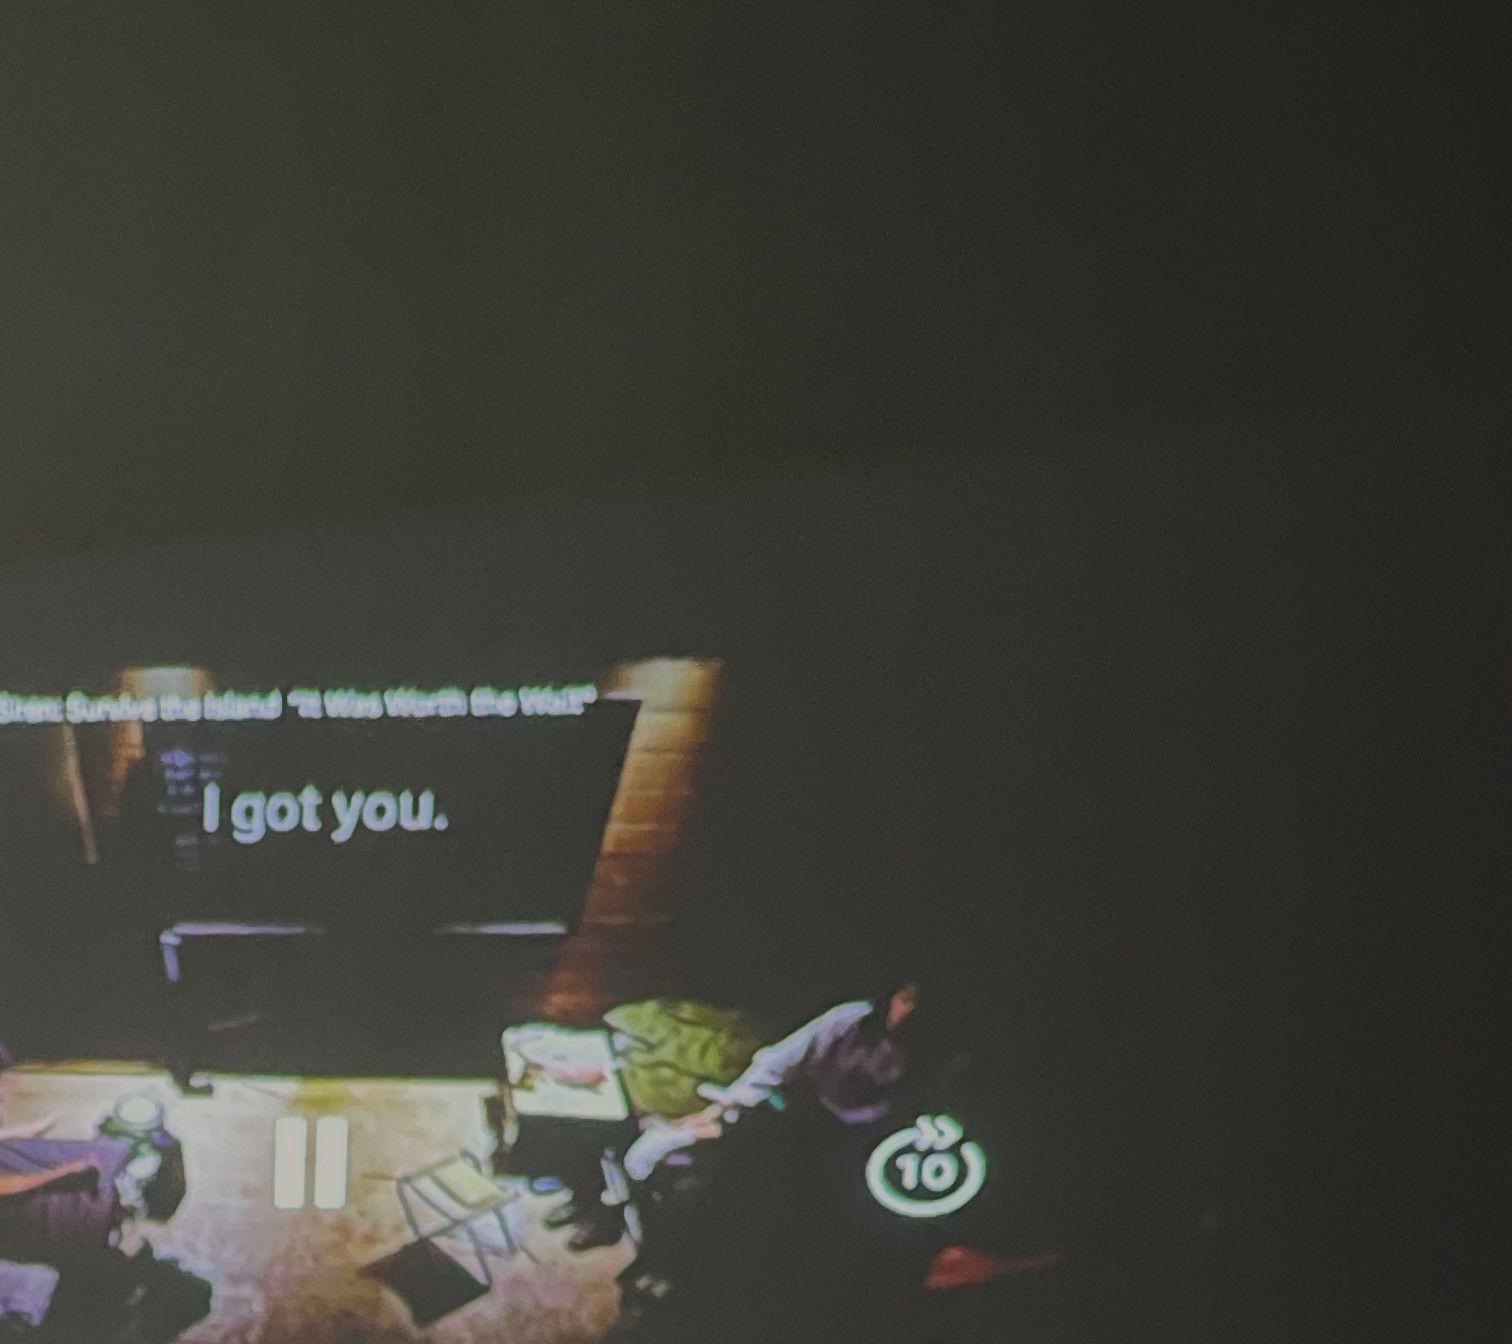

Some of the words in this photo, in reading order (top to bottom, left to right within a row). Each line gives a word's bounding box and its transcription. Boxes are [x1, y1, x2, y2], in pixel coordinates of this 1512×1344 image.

[203, 782, 220, 833] I
[231, 784, 322, 844] got
[330, 787, 449, 843] you.
[896, 1153, 959, 1192] 10
